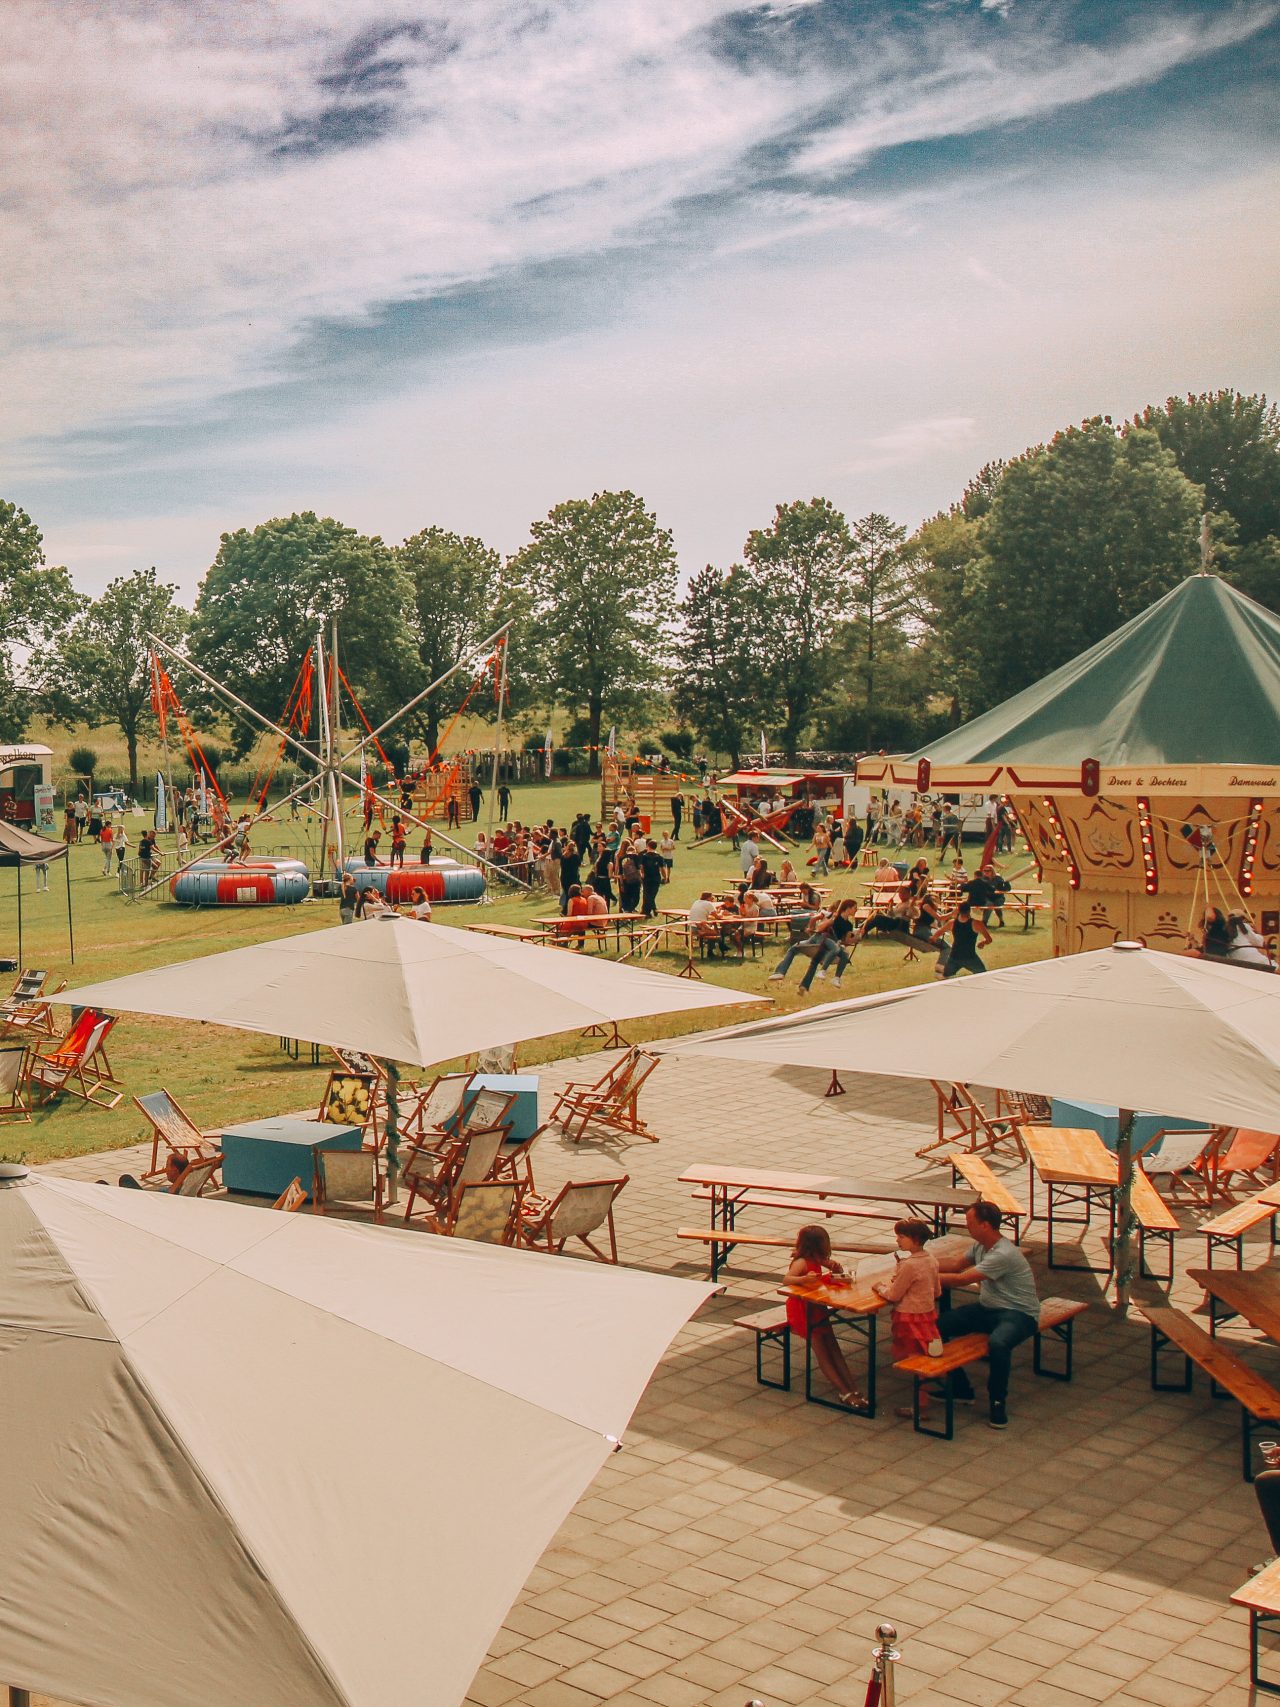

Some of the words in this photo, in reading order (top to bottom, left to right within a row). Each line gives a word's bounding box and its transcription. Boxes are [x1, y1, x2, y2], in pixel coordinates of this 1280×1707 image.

[0, 748, 36, 765] welkom
[1135, 776, 1144, 786] &
[1149, 775, 1188, 786] Dochters
